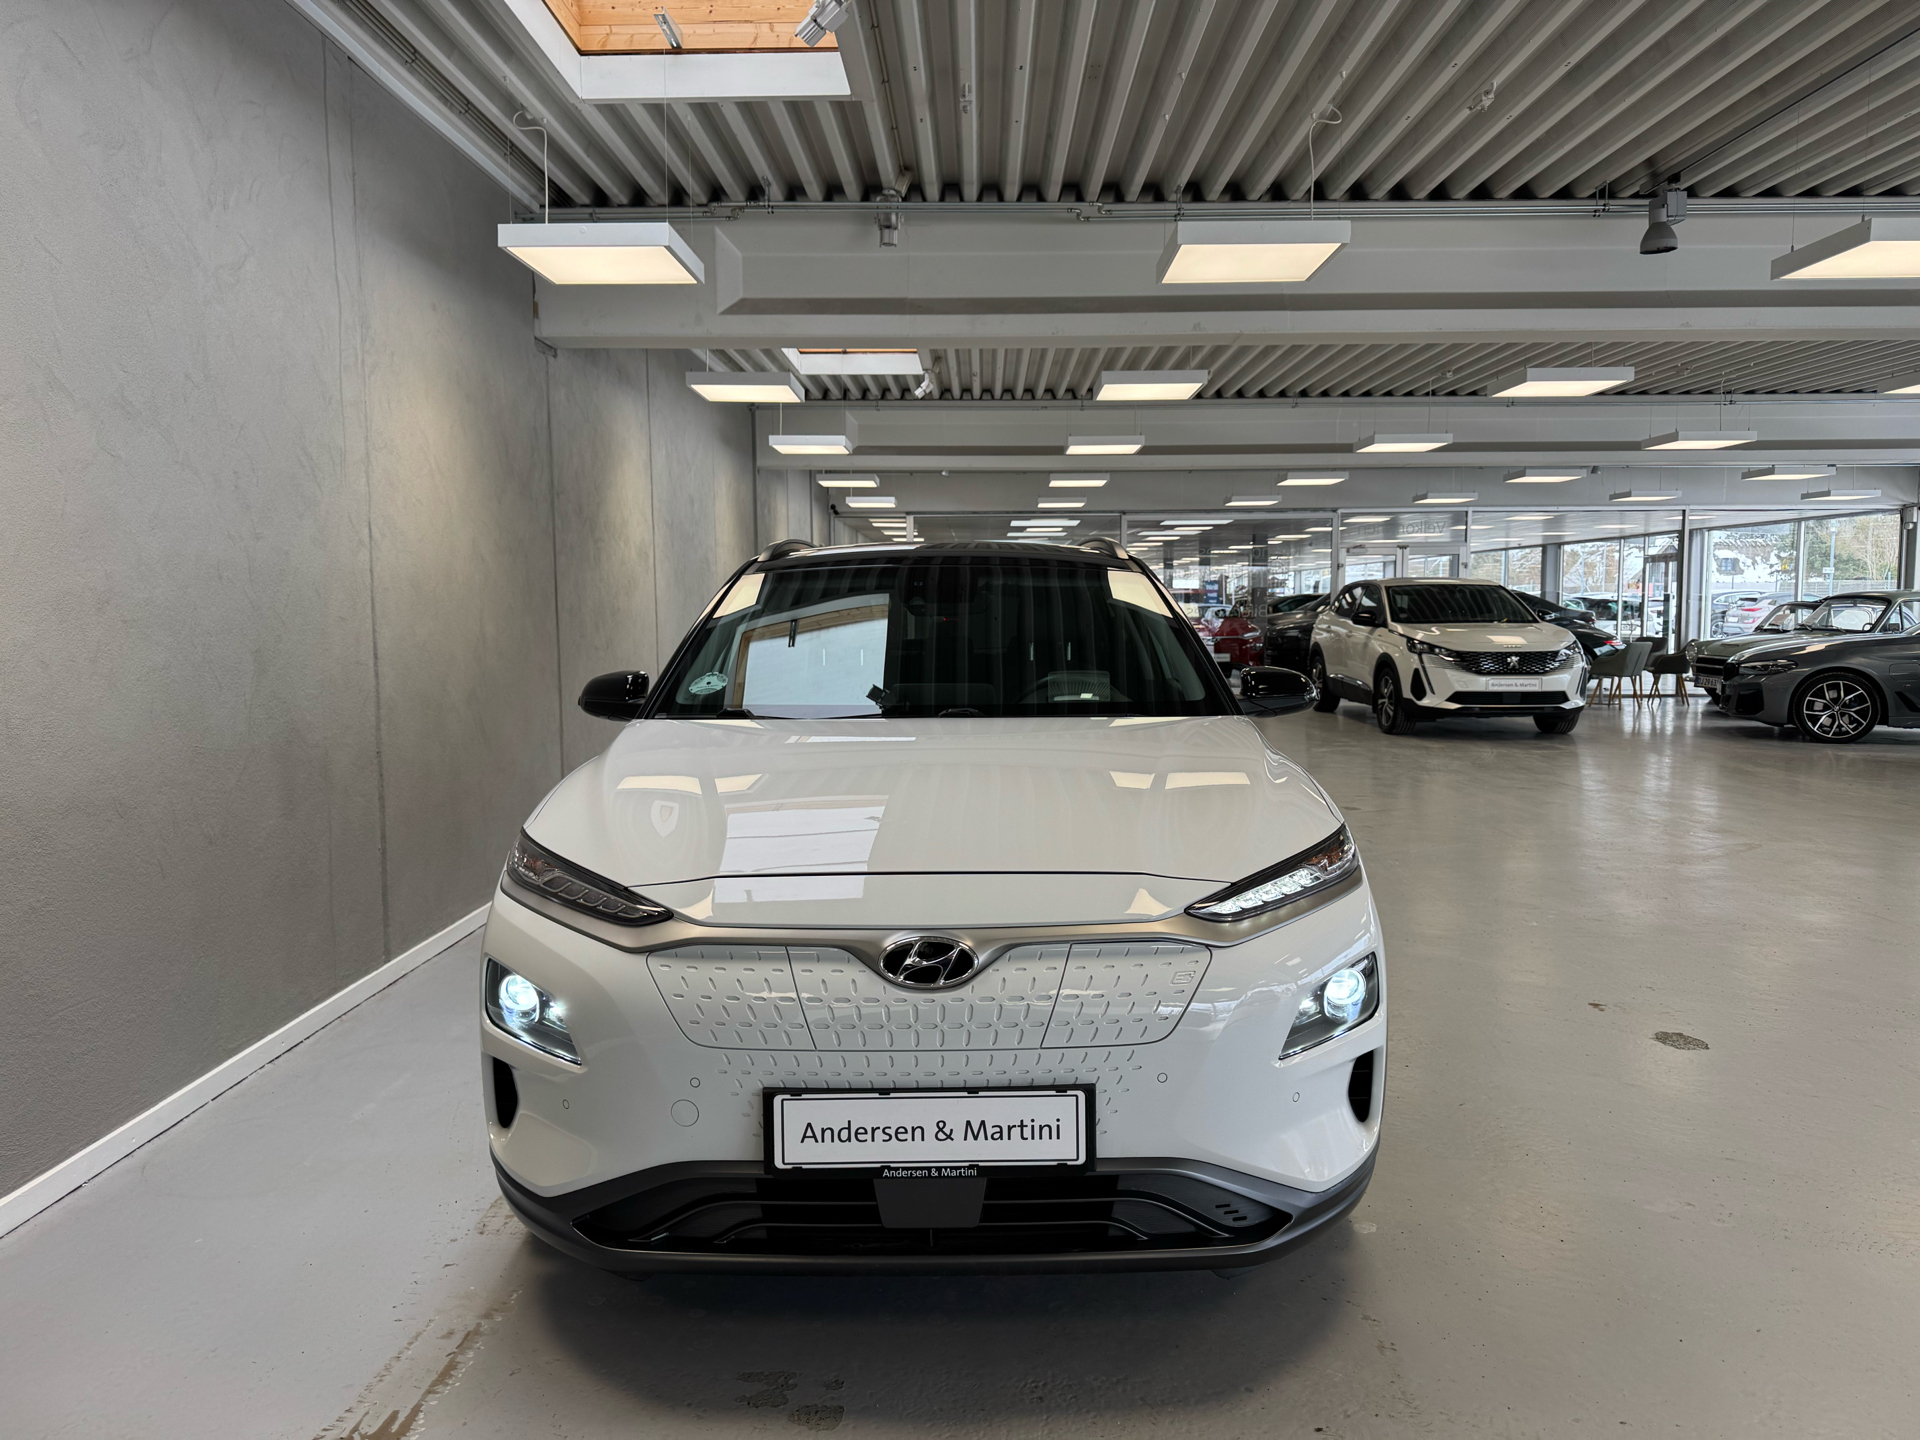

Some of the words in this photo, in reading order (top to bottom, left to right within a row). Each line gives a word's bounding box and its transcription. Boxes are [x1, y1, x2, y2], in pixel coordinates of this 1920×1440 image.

[800, 1120, 926, 1144] Andersen
[934, 1119, 955, 1142] &
[963, 1117, 1061, 1142] Martini
[882, 1168, 929, 1178] Andersen
[930, 1167, 939, 1177] &
[941, 1167, 977, 1177] Martini
